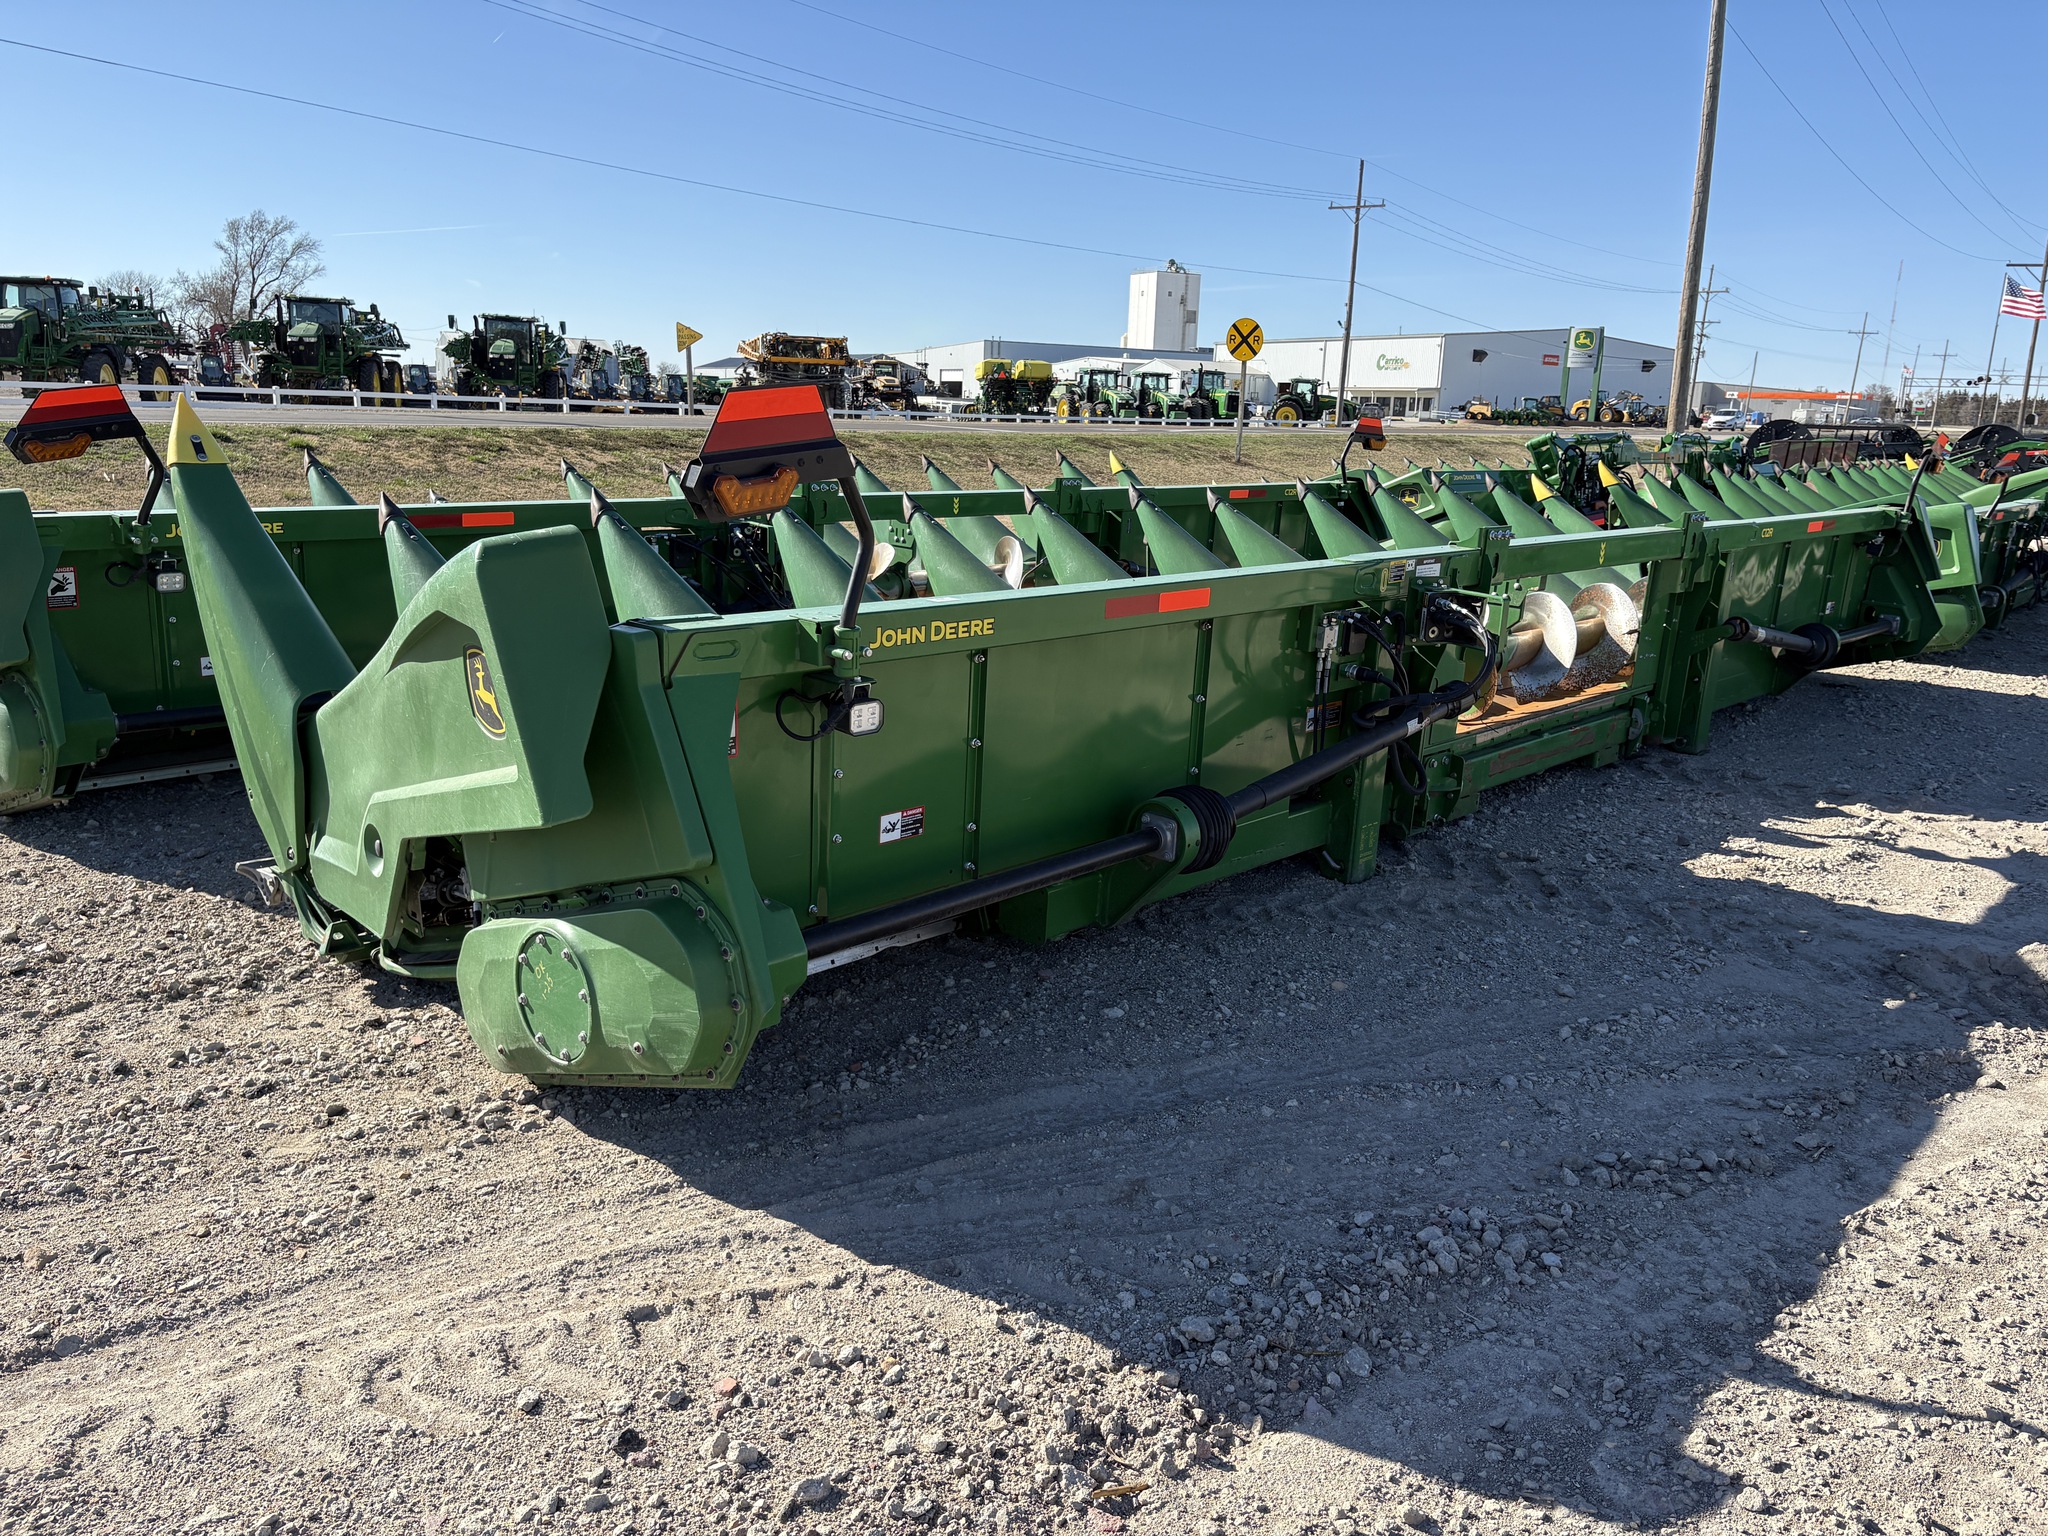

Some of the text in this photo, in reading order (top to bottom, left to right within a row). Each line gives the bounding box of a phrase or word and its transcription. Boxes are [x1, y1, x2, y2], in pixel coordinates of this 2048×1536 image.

[1229, 334, 1261, 345] R R
[1376, 353, 1405, 371] Carrico
[869, 618, 995, 649] JOHN DEERE
